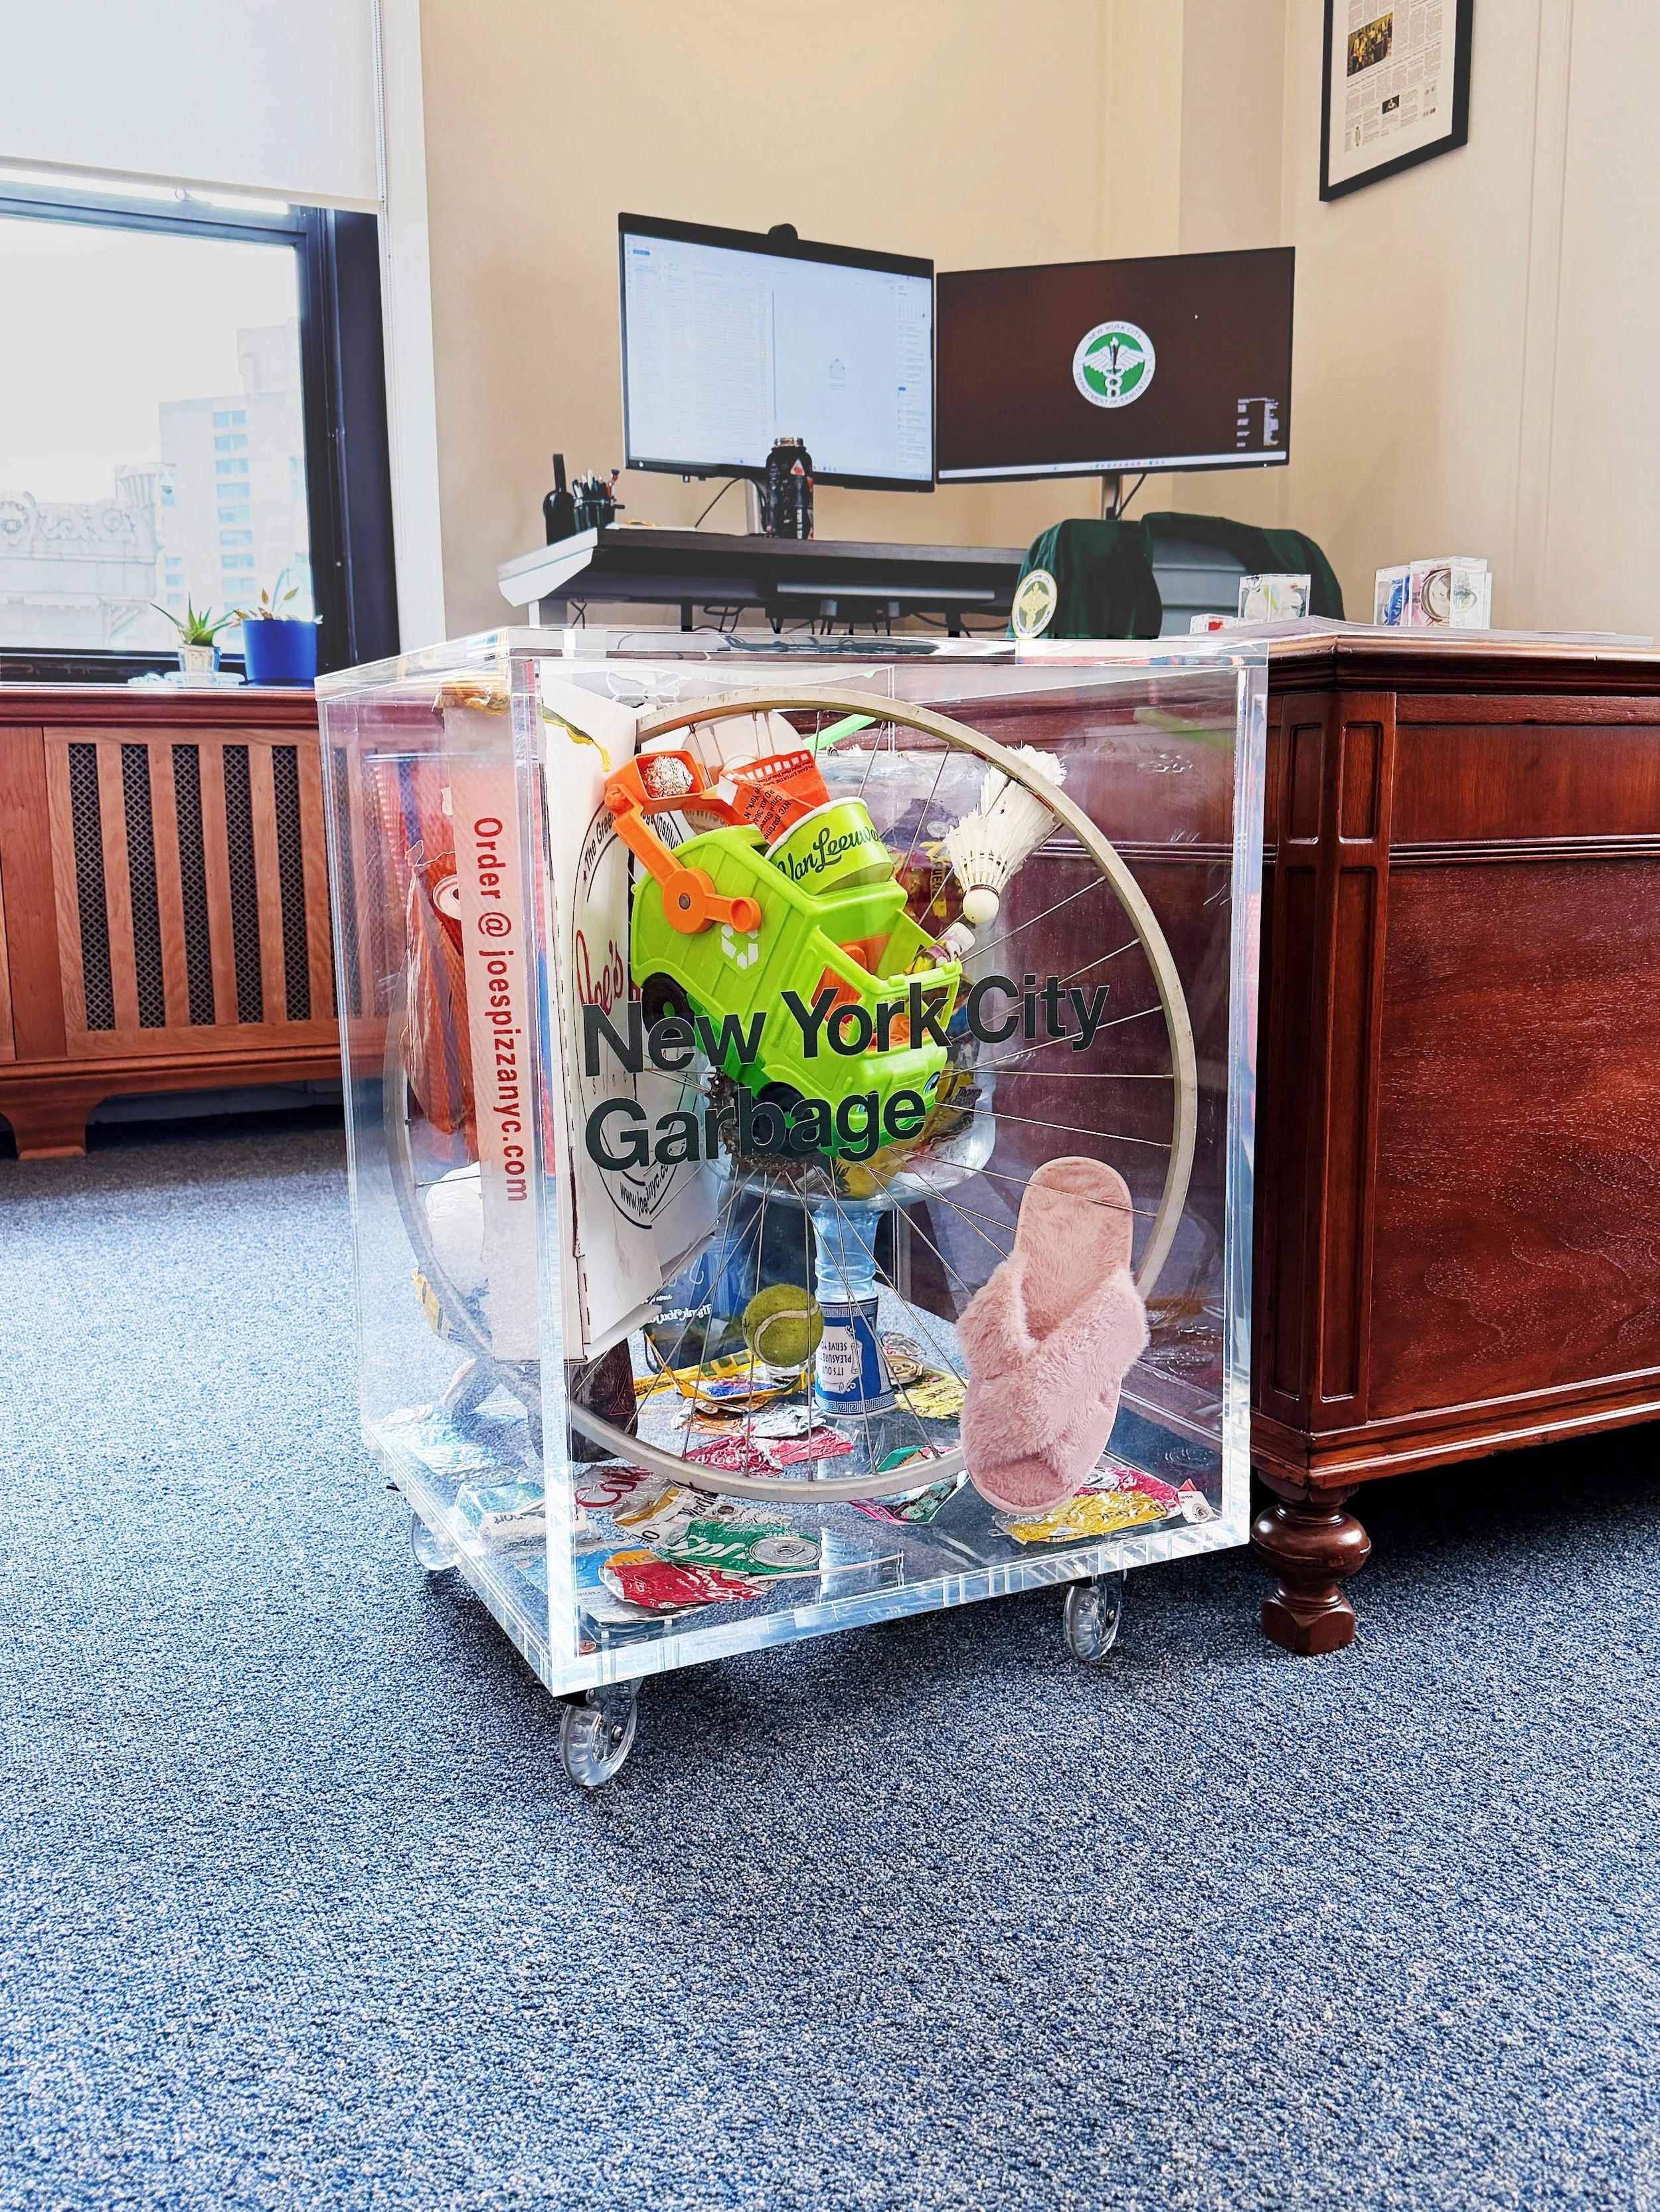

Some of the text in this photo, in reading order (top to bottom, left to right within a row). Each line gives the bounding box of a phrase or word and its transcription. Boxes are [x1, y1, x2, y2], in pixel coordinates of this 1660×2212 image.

[584, 839, 597, 872] The
[777, 827, 880, 881] Van Leeuwe
[473, 817, 529, 1202] Order @ joespizzanyc.com
[584, 973, 1110, 1077] New York City
[585, 1086, 926, 1173] Garbage
[823, 1353, 852, 1363] PLEASURE
[828, 1341, 847, 1351] SERVE
